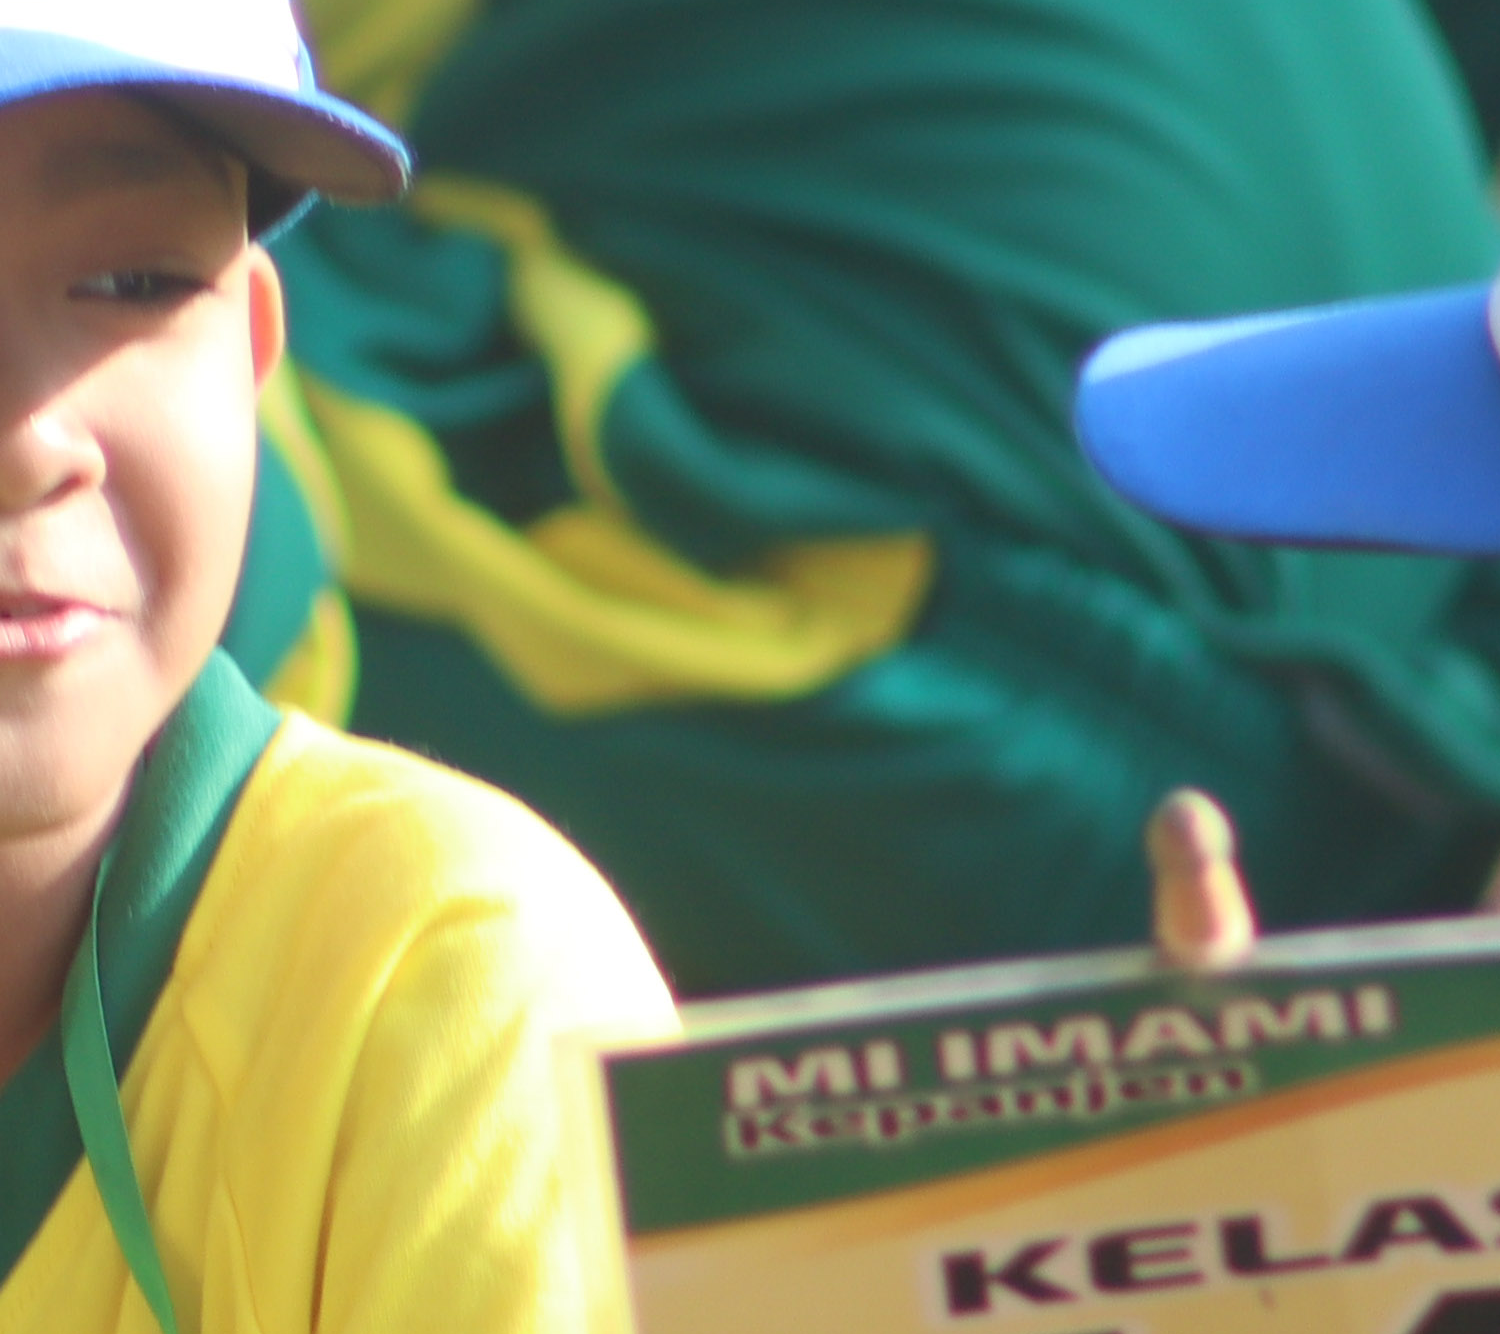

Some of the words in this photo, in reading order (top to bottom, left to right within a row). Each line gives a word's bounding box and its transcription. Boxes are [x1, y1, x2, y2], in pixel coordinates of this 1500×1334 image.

[728, 1039, 902, 1110] MI
[938, 985, 1394, 1082] IMAMI
[724, 1059, 1256, 1159] Kepanjen
